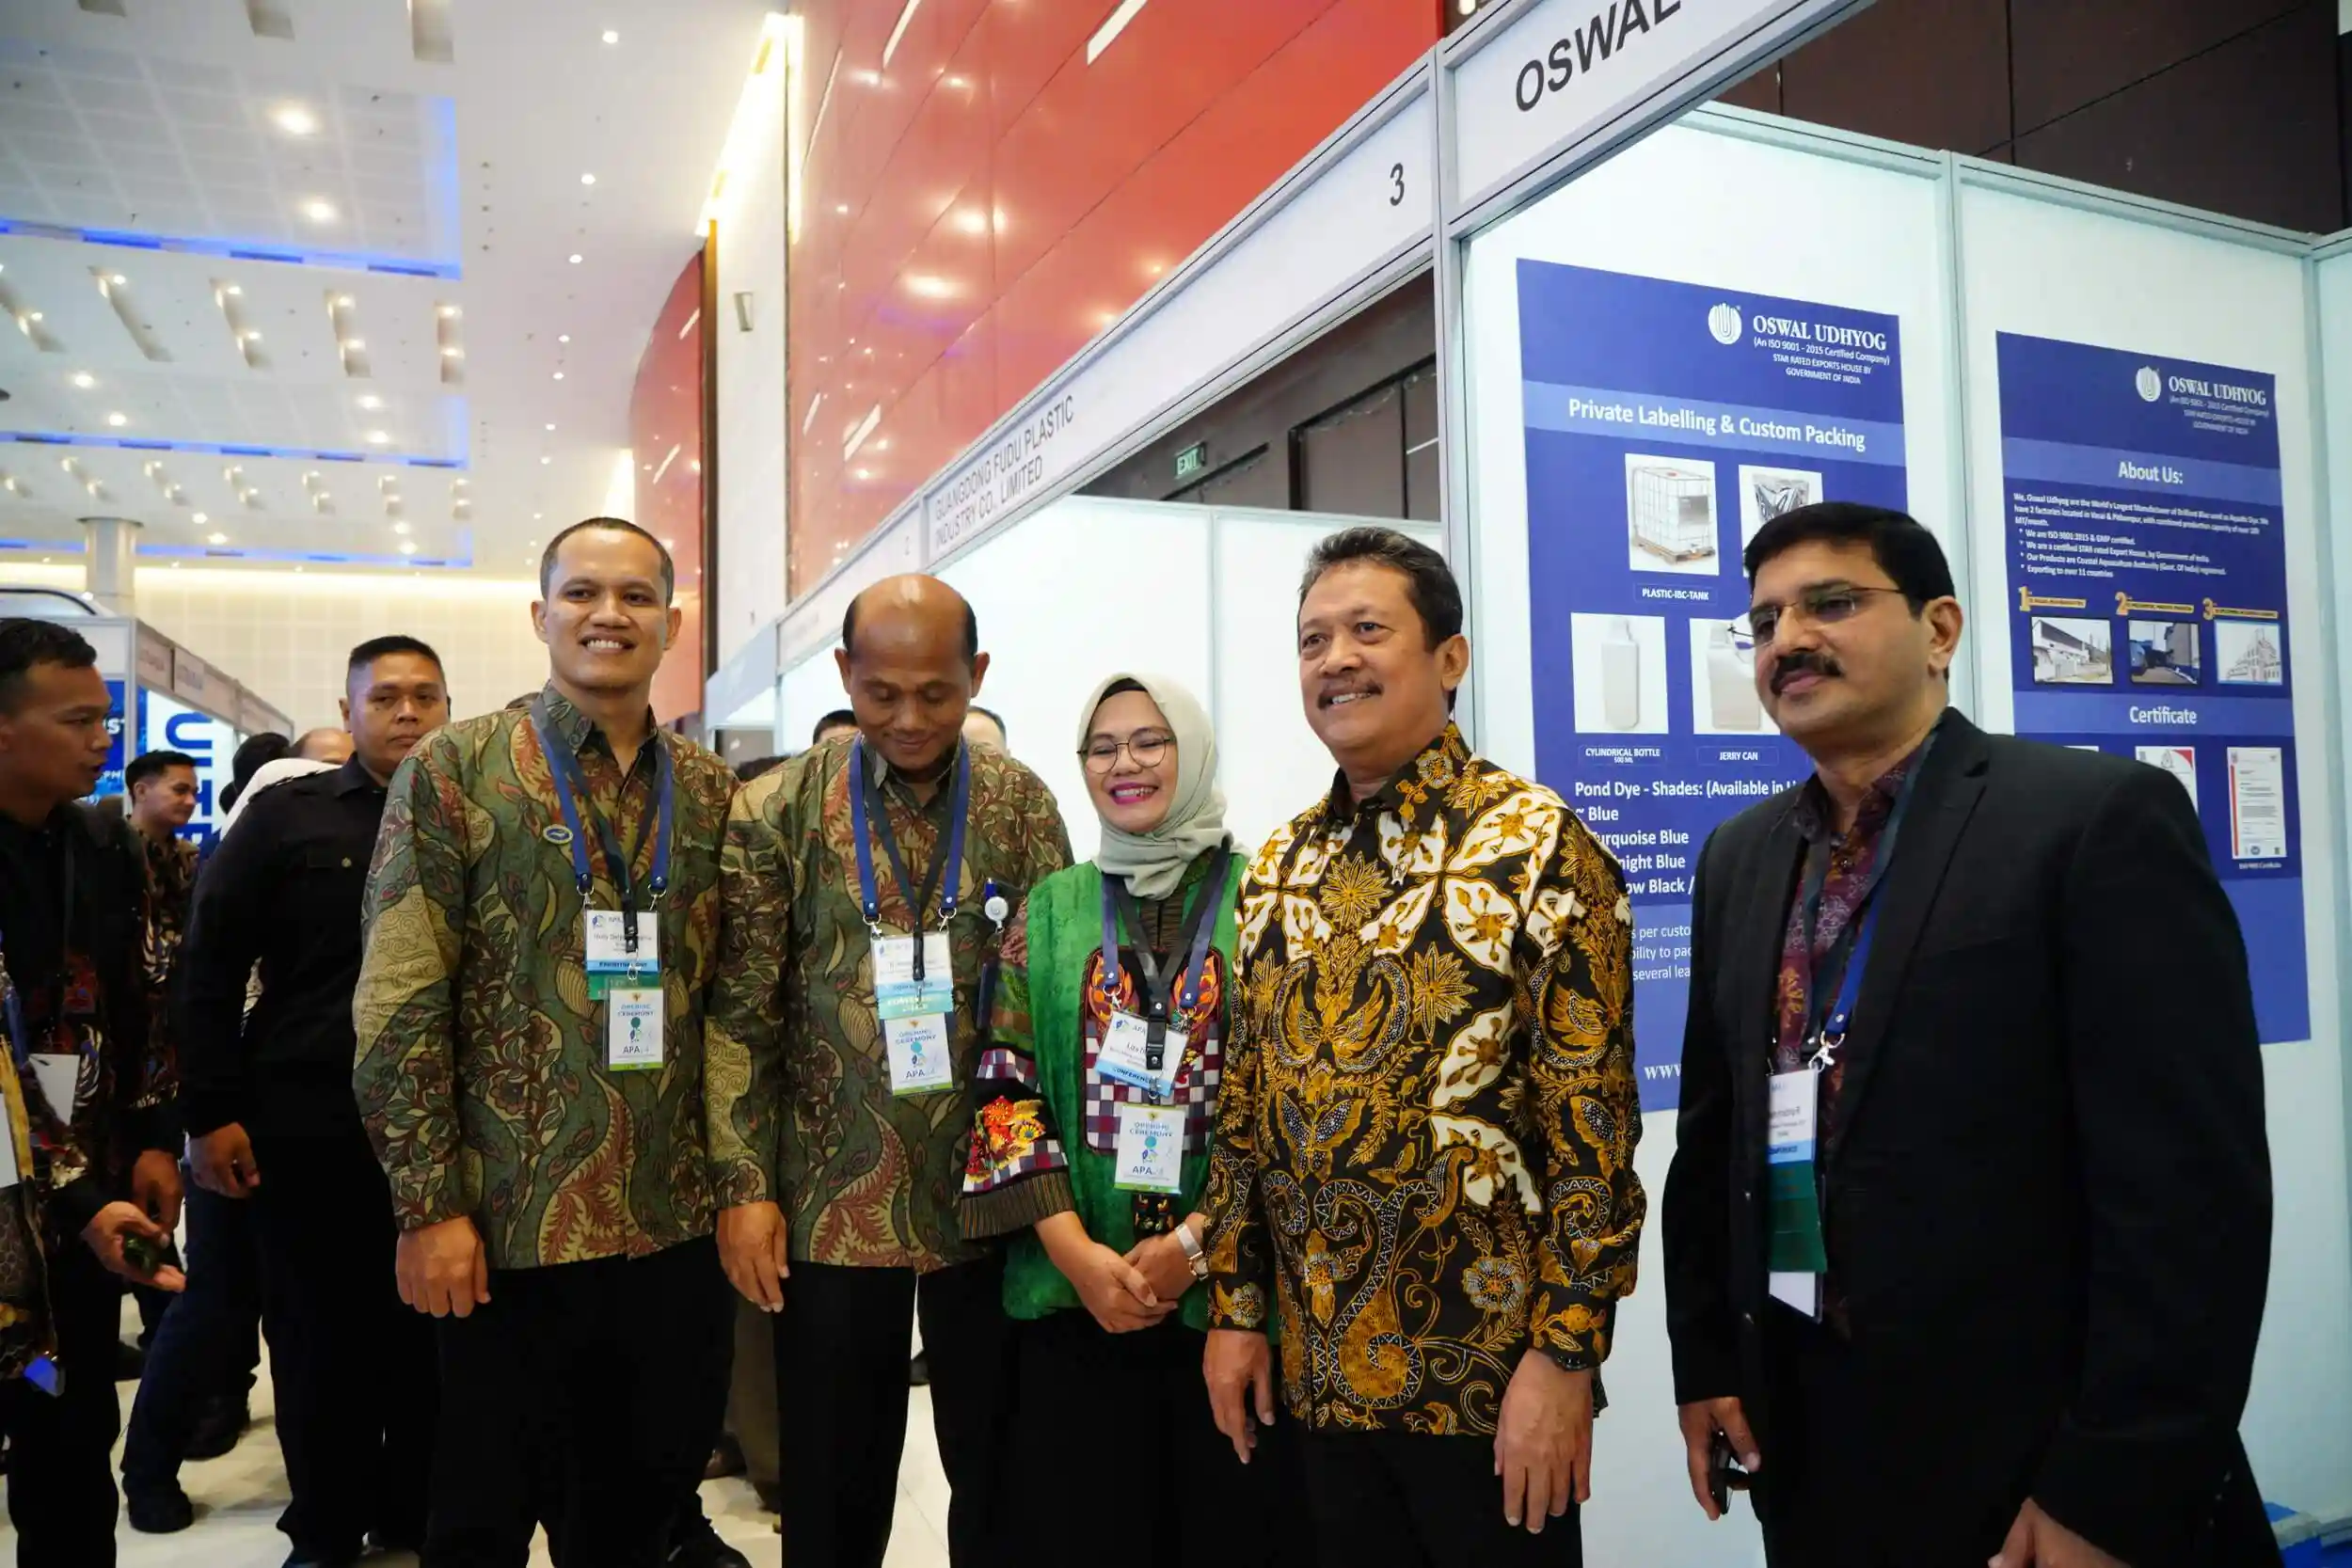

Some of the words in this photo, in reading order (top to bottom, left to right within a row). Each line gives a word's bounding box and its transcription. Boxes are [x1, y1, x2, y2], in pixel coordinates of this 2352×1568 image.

[1390, 163, 1405, 206] 3
[1753, 315, 1811, 340] OSWAL
[1814, 324, 1887, 351] UDHYOG
[2169, 375, 2213, 397] OSWAL
[2213, 383, 2266, 405] UDHYOG
[1568, 398, 1633, 422] Private
[1638, 405, 1717, 436] Labelling
[1720, 414, 1735, 434] &
[1740, 417, 1802, 440] Custom
[1805, 424, 1866, 452] Packing
[993, 436, 1022, 479] FUDU
[1024, 394, 1074, 455] PLASTIC
[1000, 454, 1043, 504] LIMITED
[2119, 461, 2159, 483] About
[2162, 465, 2184, 485] Us:
[2129, 705, 2198, 724] Certificate
[1720, 752, 1740, 761] JERRY
[1742, 752, 1758, 761] CAN
[1575, 781, 1611, 797] Pond
[1614, 781, 1641, 800] Dye
[1652, 780, 1703, 797] Shades:
[1707, 780, 1769, 798] (Available
[1588, 805, 1619, 821] Blue
[1593, 830, 1656, 848] urquoise
[1660, 829, 1690, 845] Blue
[1656, 853, 1686, 869] Blue
[1648, 877, 1685, 894] Black
[1639, 927, 1658, 941] per
[1660, 946, 1671, 958] to
[1633, 965, 1671, 981] several
